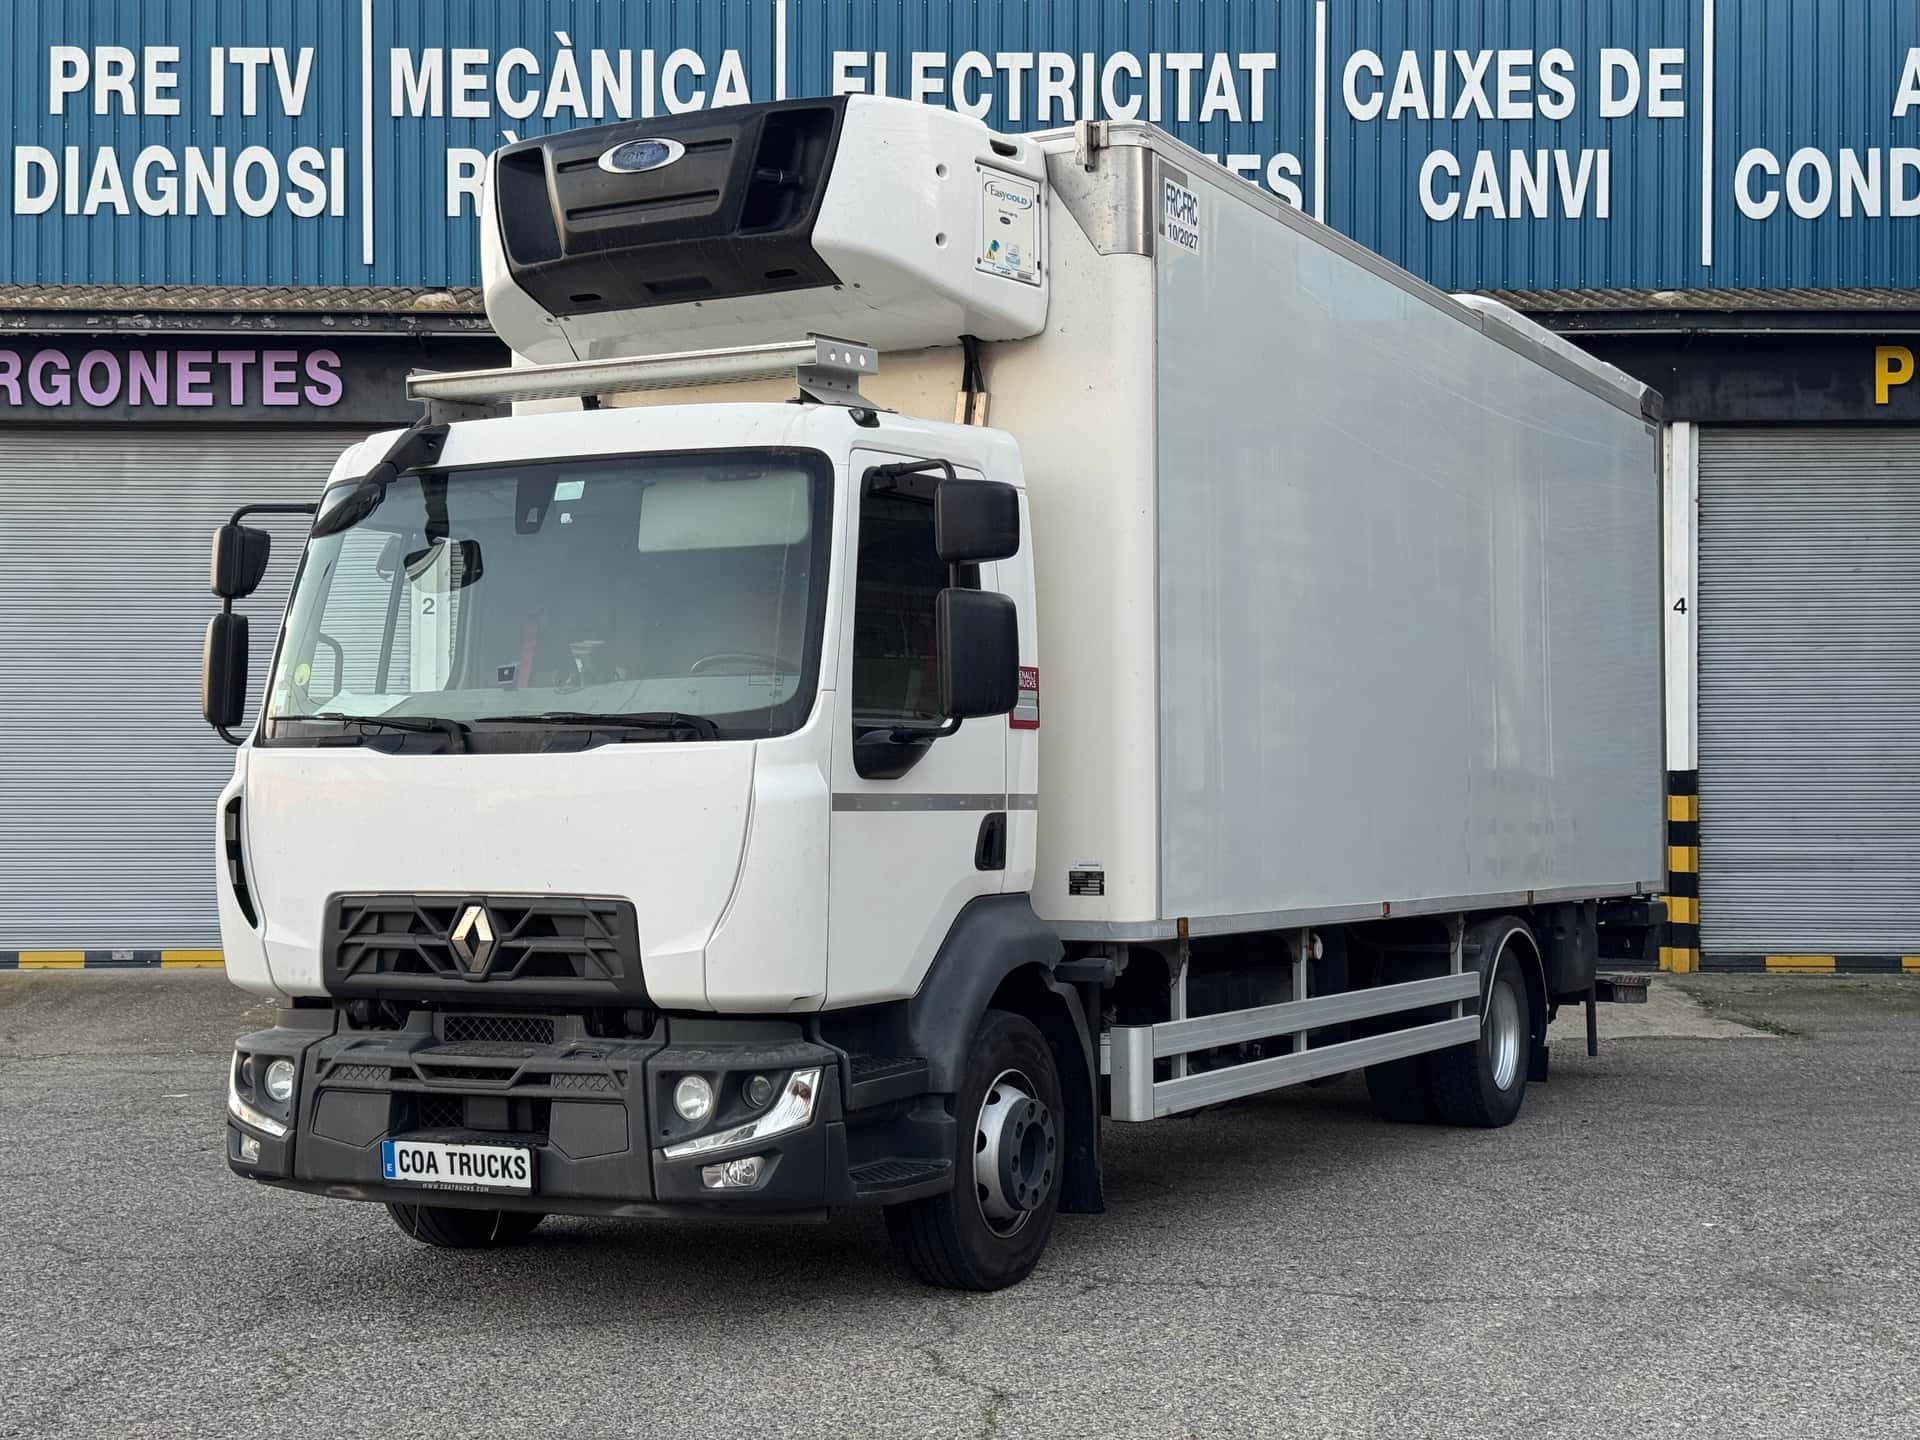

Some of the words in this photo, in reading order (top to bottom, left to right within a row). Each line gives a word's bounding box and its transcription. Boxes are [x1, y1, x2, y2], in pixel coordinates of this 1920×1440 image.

[50, 46, 180, 115] PRE
[210, 47, 314, 116] ITV
[391, 31, 750, 118] MECÀNICA
[1343, 48, 1576, 121] CAIXES
[1599, 48, 1685, 118] DE
[15, 146, 344, 217] DIAGNOSI
[1166, 183, 1197, 226] FRC-FRC
[1419, 149, 1609, 220] CANVI
[1168, 223, 1198, 250] 10/2027
[422, 597, 435, 615] 2
[1673, 597, 1688, 615] 4
[398, 1149, 439, 1174] COA
[445, 1151, 527, 1180] TRUCKS
